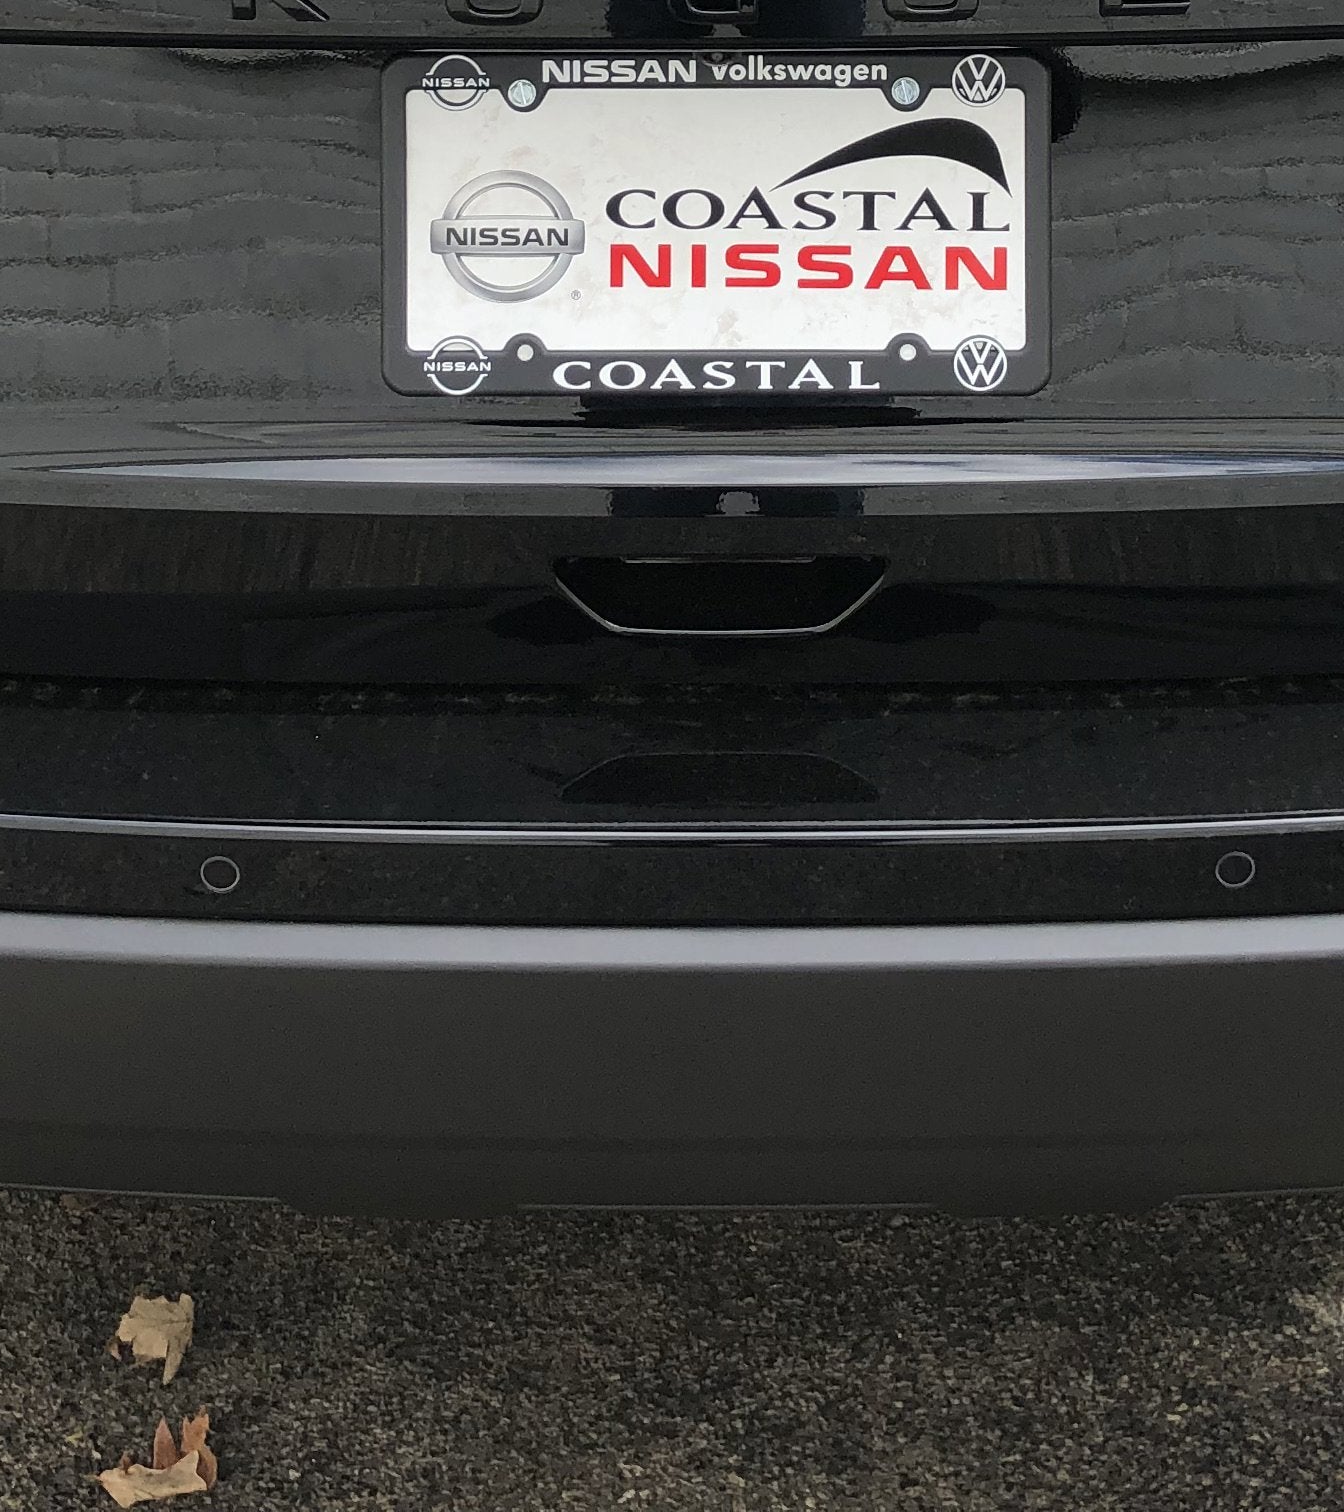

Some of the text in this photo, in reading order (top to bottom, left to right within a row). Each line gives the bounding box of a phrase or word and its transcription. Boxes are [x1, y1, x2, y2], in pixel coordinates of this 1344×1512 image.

[422, 77, 490, 88] NISSAN
[542, 59, 697, 83] NISSAN
[605, 187, 1012, 232] COASTAL
[446, 227, 569, 247] NISSAN
[609, 243, 1008, 291] NISSAN
[423, 361, 492, 372] NISSAN
[552, 358, 881, 390] COASTAL
